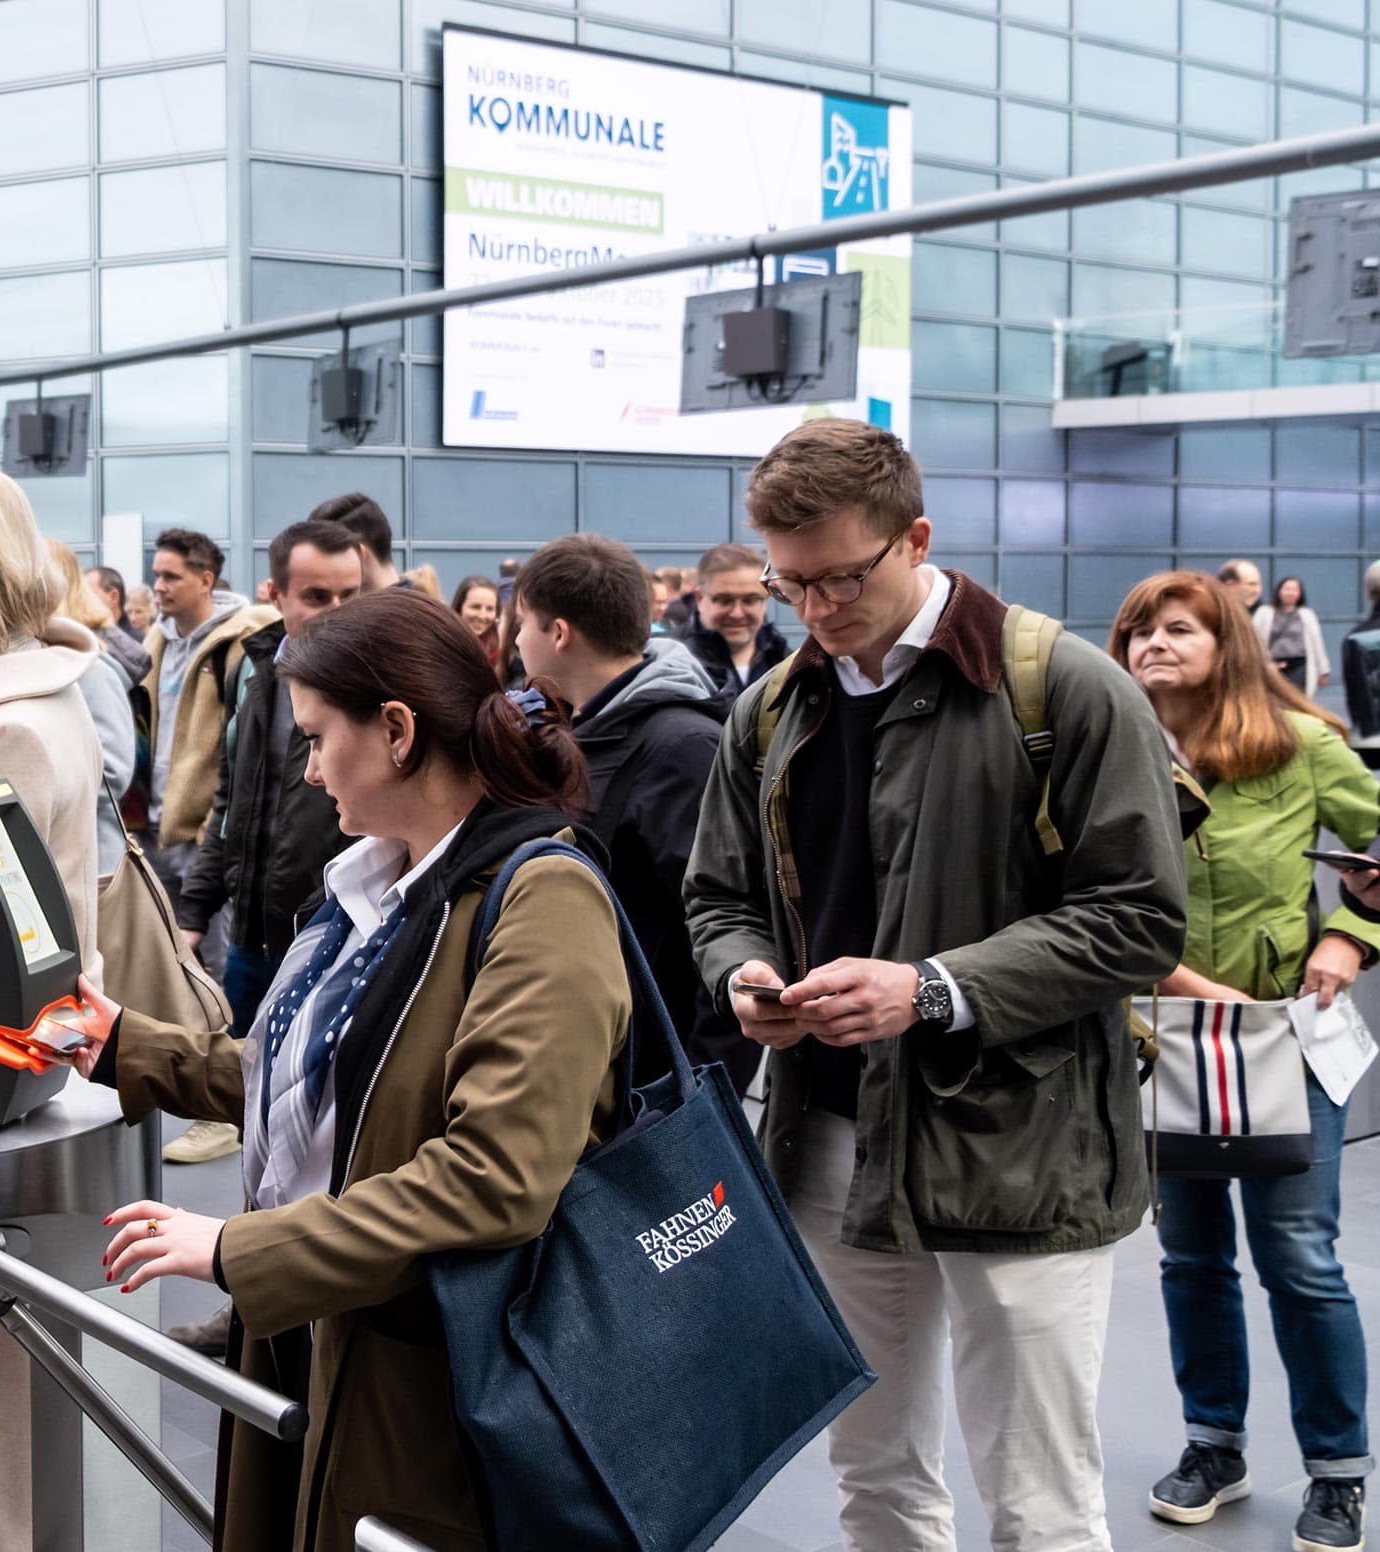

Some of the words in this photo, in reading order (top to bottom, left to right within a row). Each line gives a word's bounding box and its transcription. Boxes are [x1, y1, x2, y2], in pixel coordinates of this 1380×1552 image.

[468, 65, 570, 97] NÜRNBERG
[469, 94, 664, 152] KOMMUNALE
[466, 177, 662, 228] WILLKOMMEN
[468, 233, 627, 269] NürnbergM
[623, 287, 666, 308] 2025
[635, 1193, 718, 1253] FAHNEN
[648, 1204, 737, 1273] KÖSSINGER
